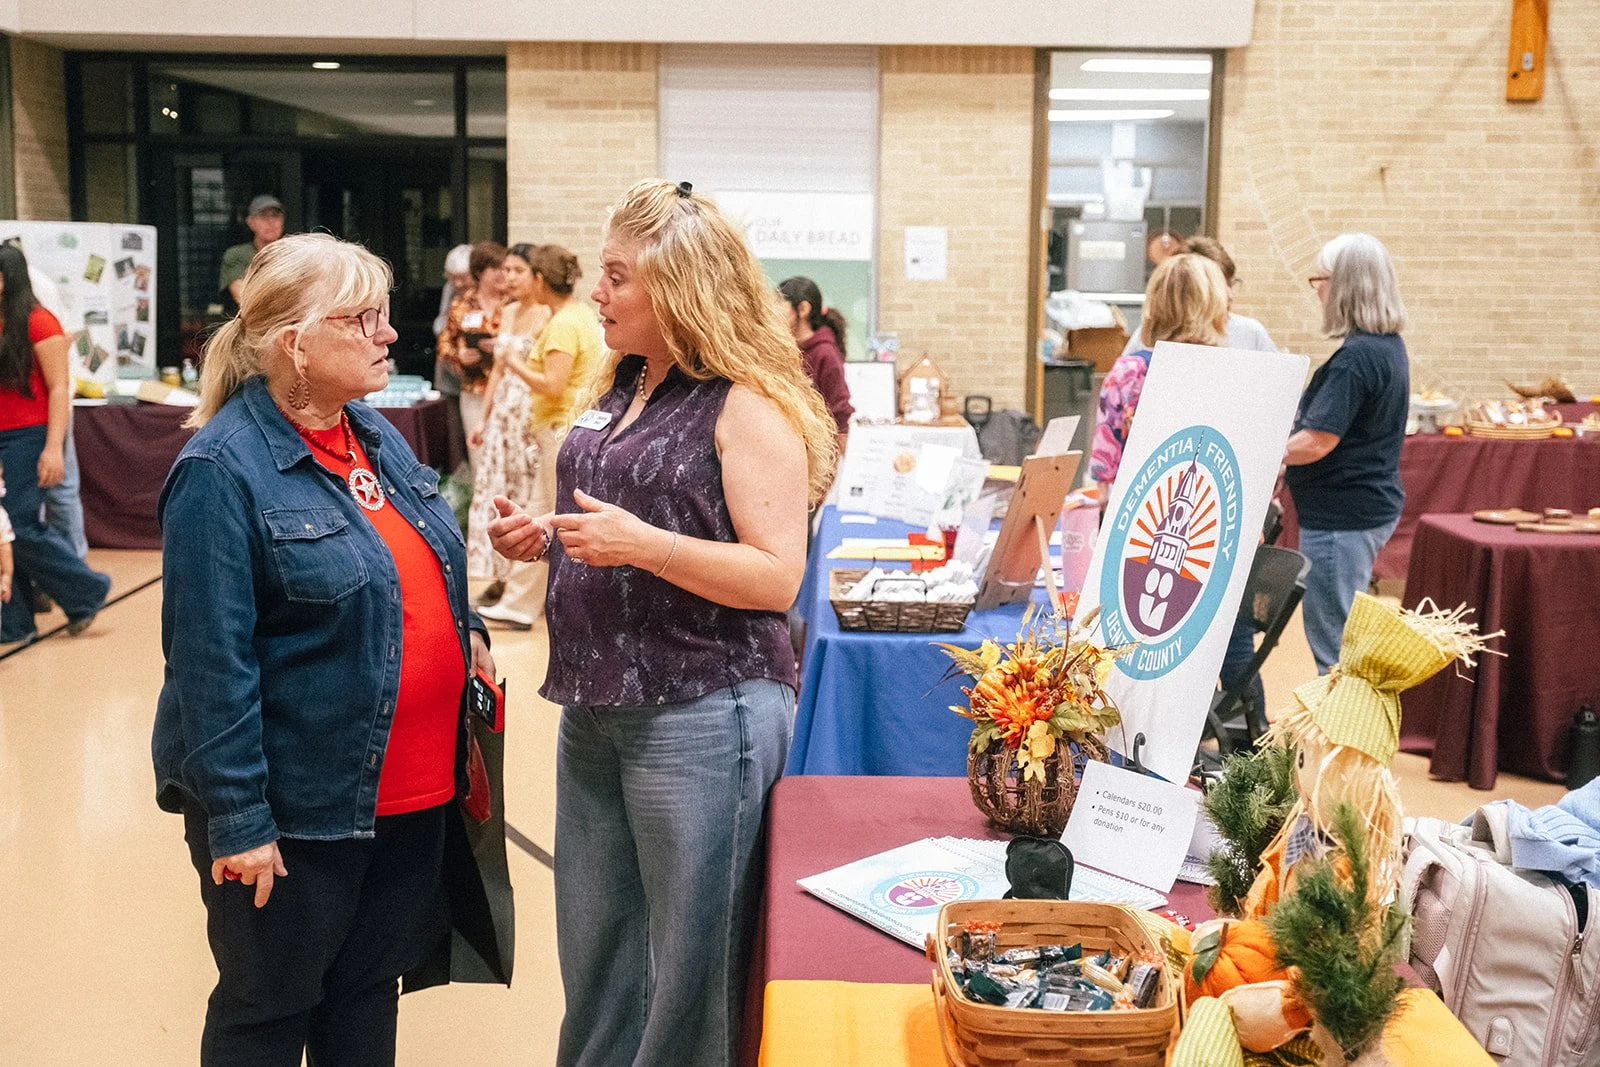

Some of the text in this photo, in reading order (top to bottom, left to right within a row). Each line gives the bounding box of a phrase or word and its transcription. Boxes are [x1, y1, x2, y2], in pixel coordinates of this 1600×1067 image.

[756, 230, 861, 246] DAILY BREAD
[1117, 437, 1237, 561] DEMENTIA FRIENDLY
[1106, 609, 1182, 671] DENTN COUNTY
[1102, 790, 1163, 816] Calendars $20.00
[1093, 817, 1124, 833] donation
[1098, 804, 1166, 834] Pens $10 or for any
